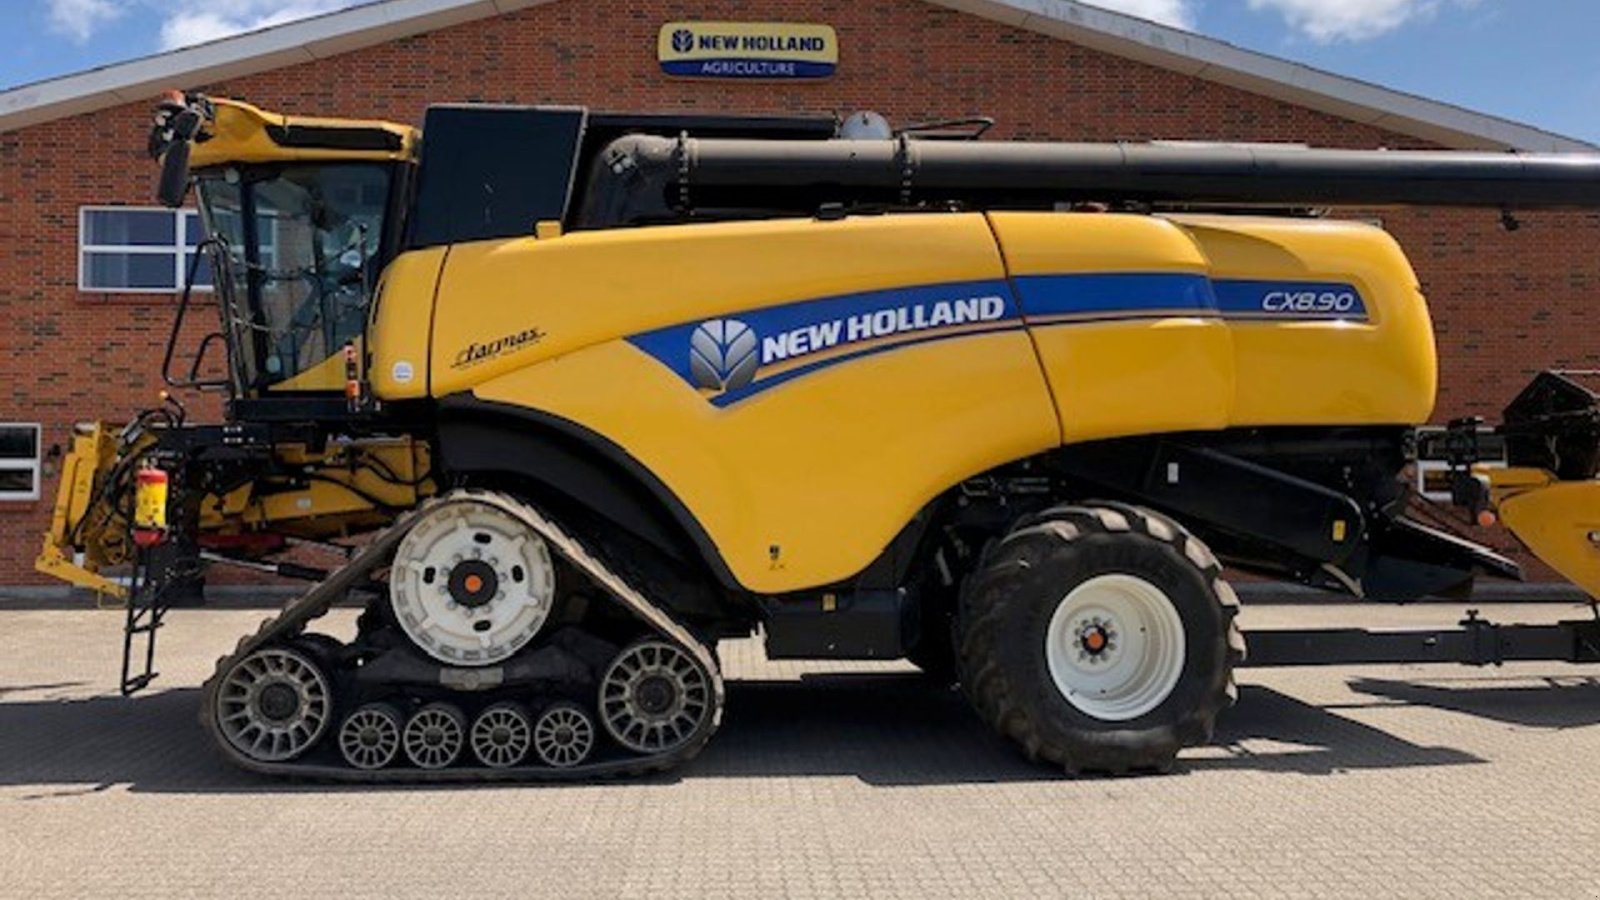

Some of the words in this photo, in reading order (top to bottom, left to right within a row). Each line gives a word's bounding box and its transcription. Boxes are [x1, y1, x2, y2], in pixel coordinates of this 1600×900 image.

[699, 35, 738, 51] NEW
[743, 36, 824, 52] HOLLAND
[701, 62, 796, 76] AGRICULTURE
[1262, 291, 1354, 312] CX8.90
[763, 321, 840, 363] NEW
[847, 297, 1005, 341] HOLLAND
